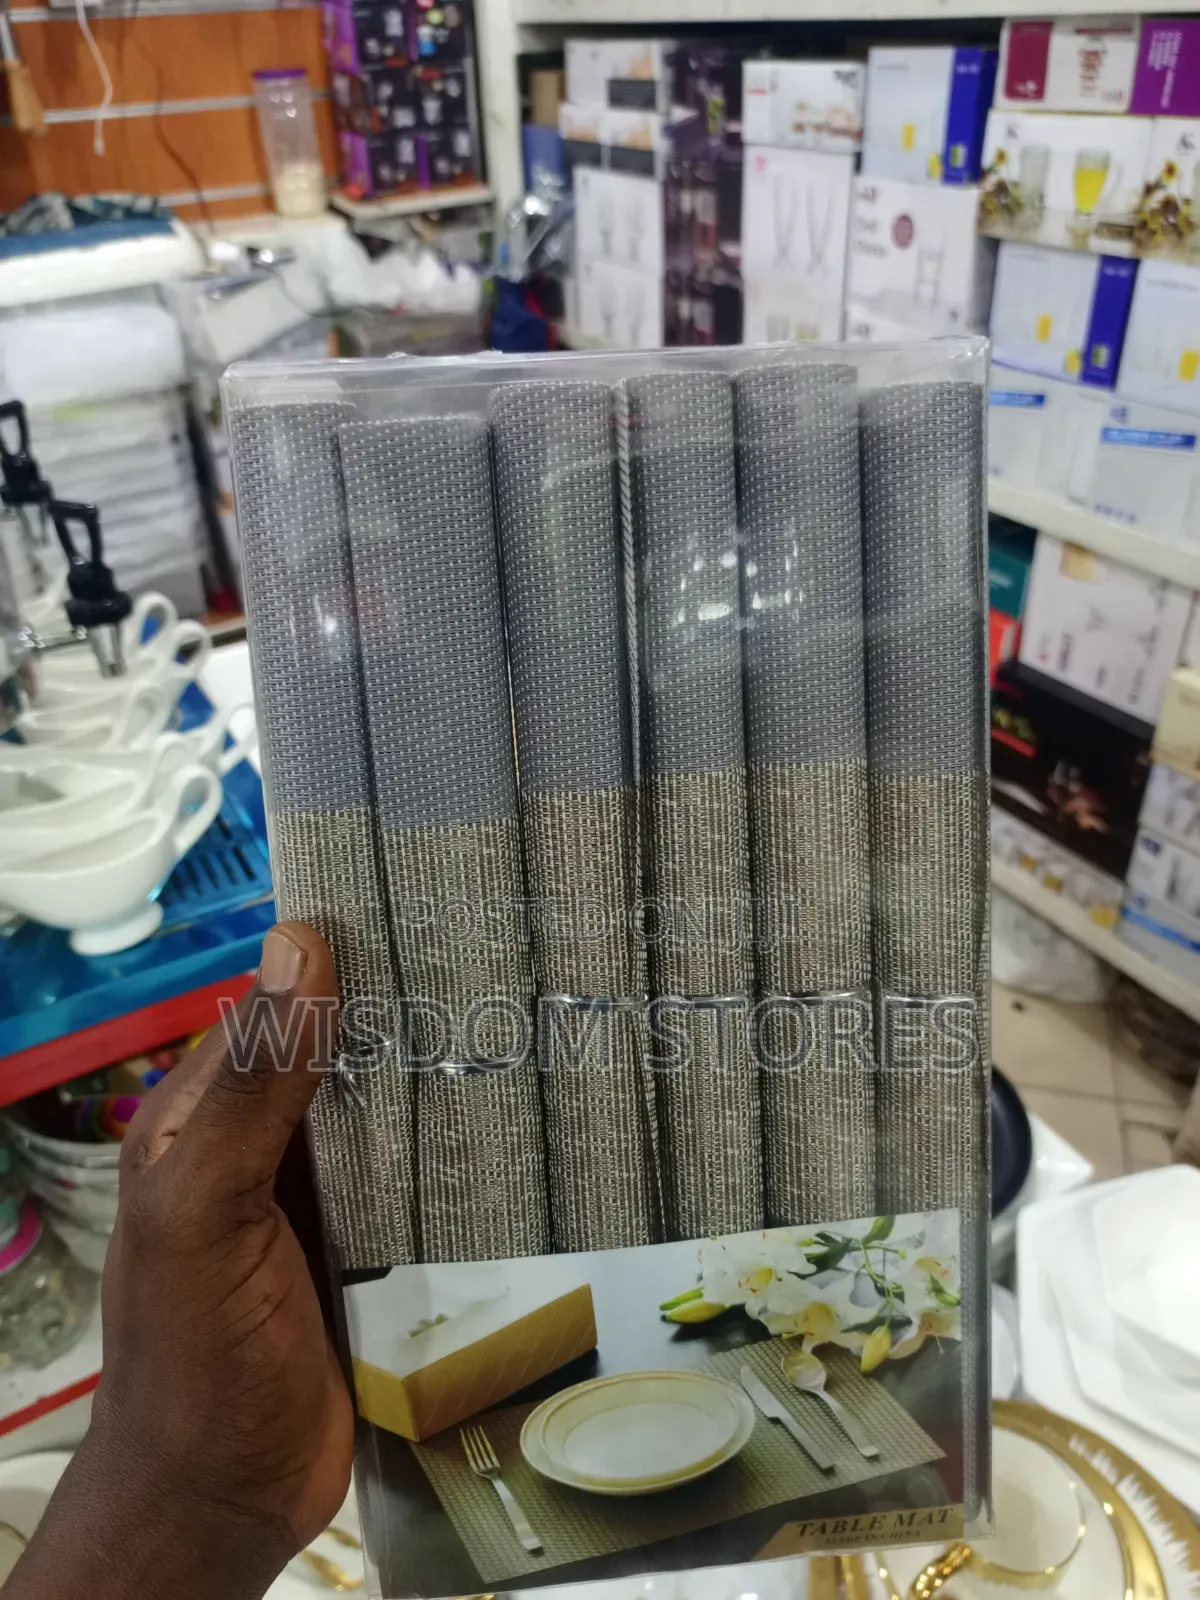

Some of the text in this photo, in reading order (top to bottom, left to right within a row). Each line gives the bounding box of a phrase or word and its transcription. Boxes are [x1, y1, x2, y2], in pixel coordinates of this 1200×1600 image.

[797, 1507, 954, 1538] TABLE MAT
[879, 1529, 921, 1541] CHINA
